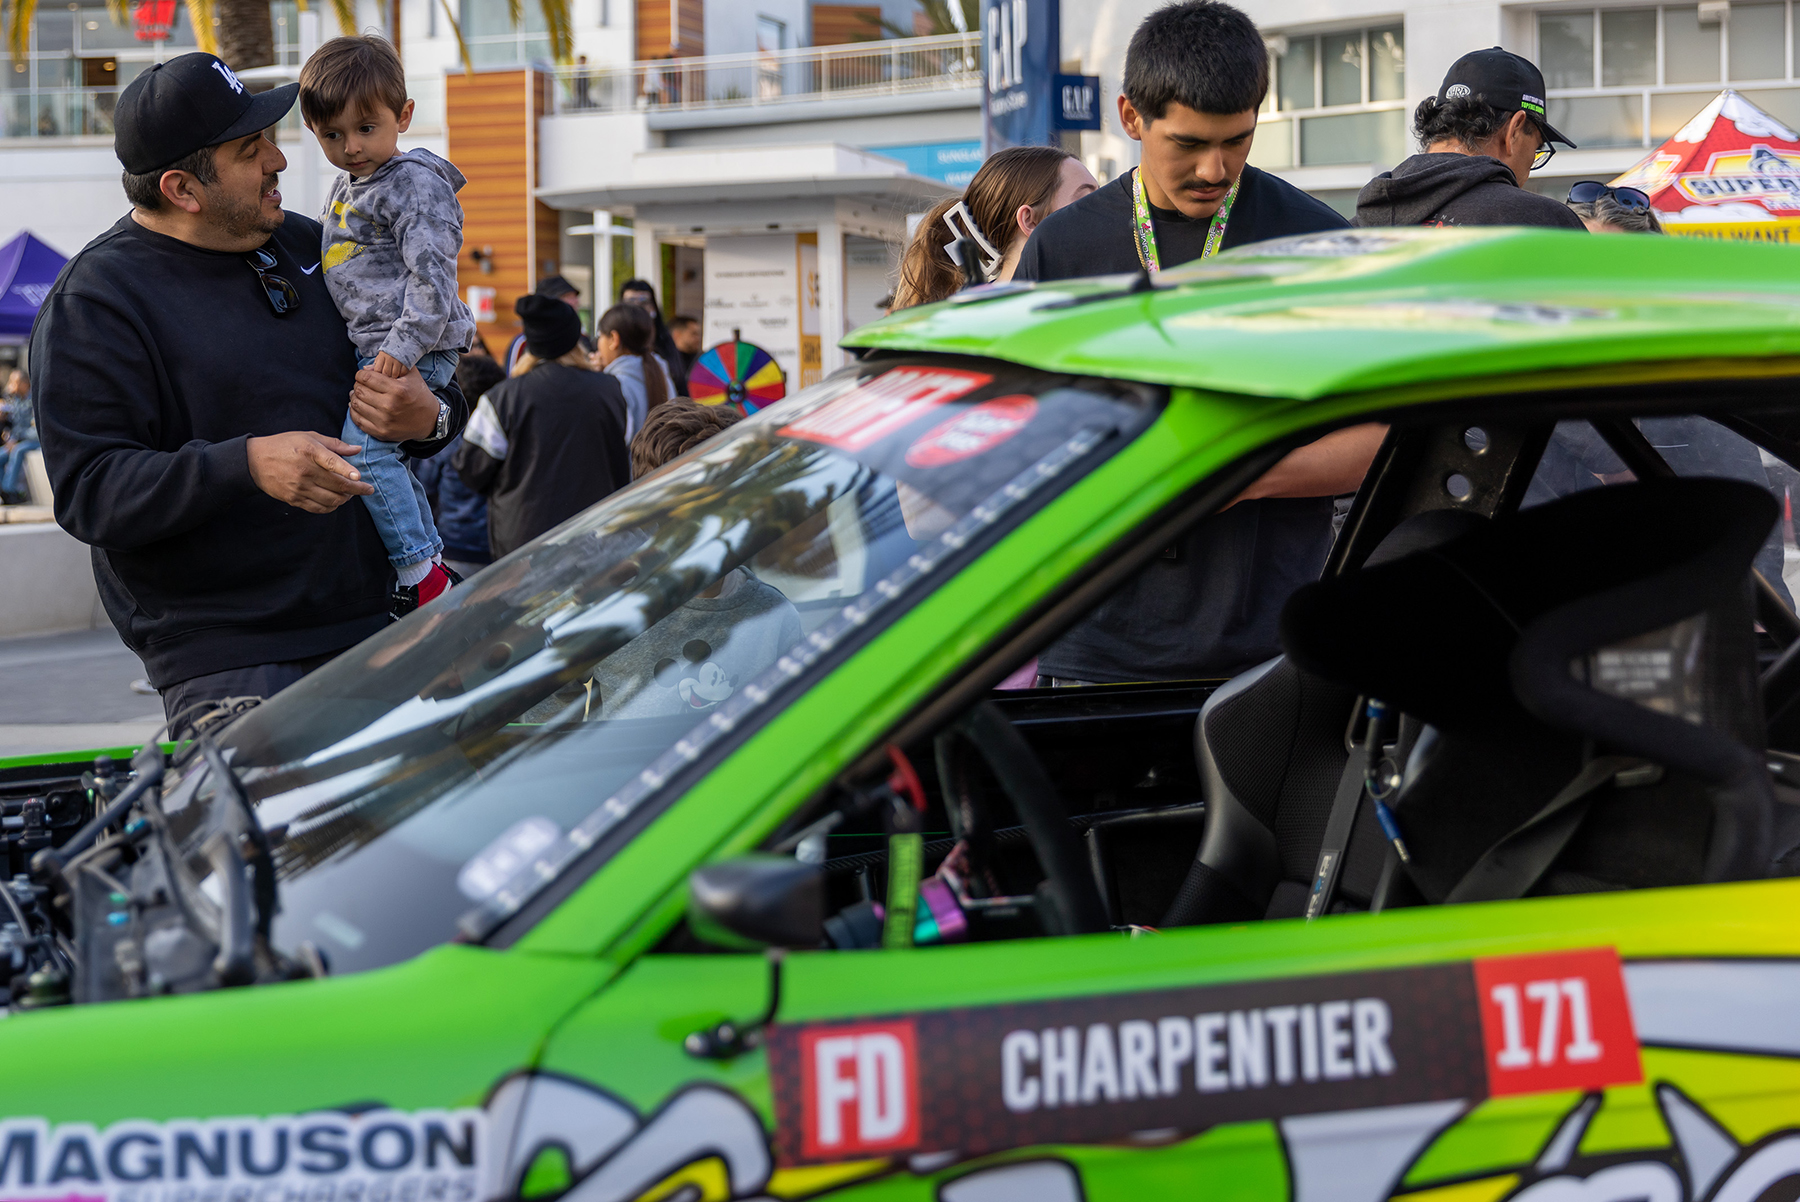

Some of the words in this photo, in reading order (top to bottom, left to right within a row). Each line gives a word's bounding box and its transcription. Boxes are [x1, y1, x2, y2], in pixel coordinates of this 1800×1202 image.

[988, 0, 1027, 94] GAP
[1062, 85, 1093, 114] GAP
[1003, 998, 1396, 1112] CHARPENTIER
[1491, 977, 1603, 1070] 171
[813, 1032, 909, 1148] FD
[0, 1119, 476, 1186] MAGNUSON
